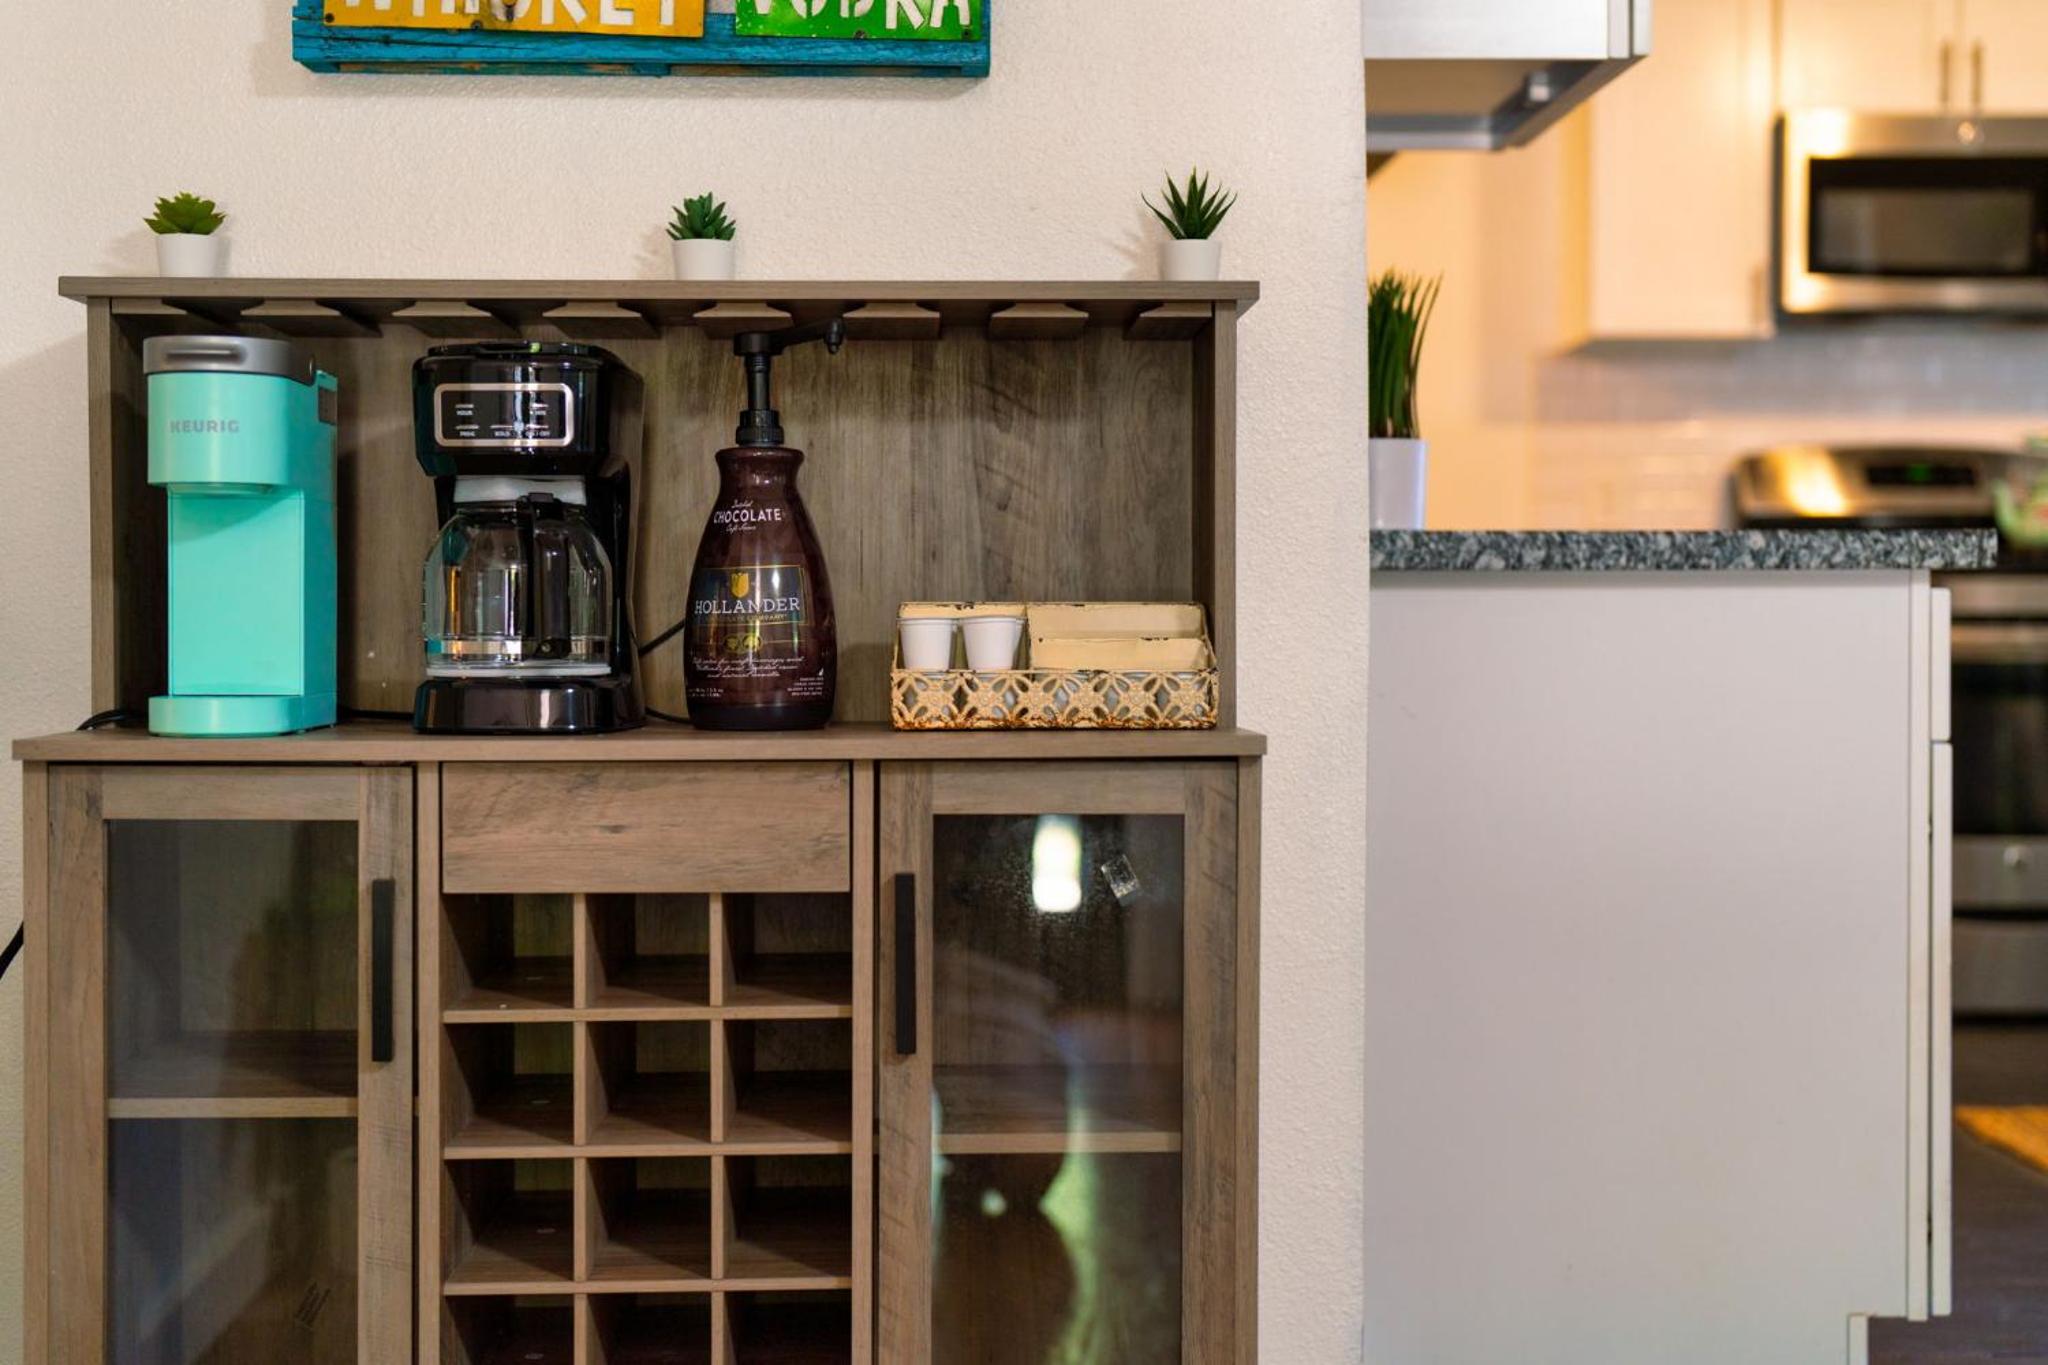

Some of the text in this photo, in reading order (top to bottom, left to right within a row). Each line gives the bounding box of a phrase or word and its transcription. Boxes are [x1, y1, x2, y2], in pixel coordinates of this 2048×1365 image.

[169, 419, 240, 433] KEURIG
[713, 508, 782, 524] CHOCOLATE
[695, 597, 800, 614] HOLLANDER
